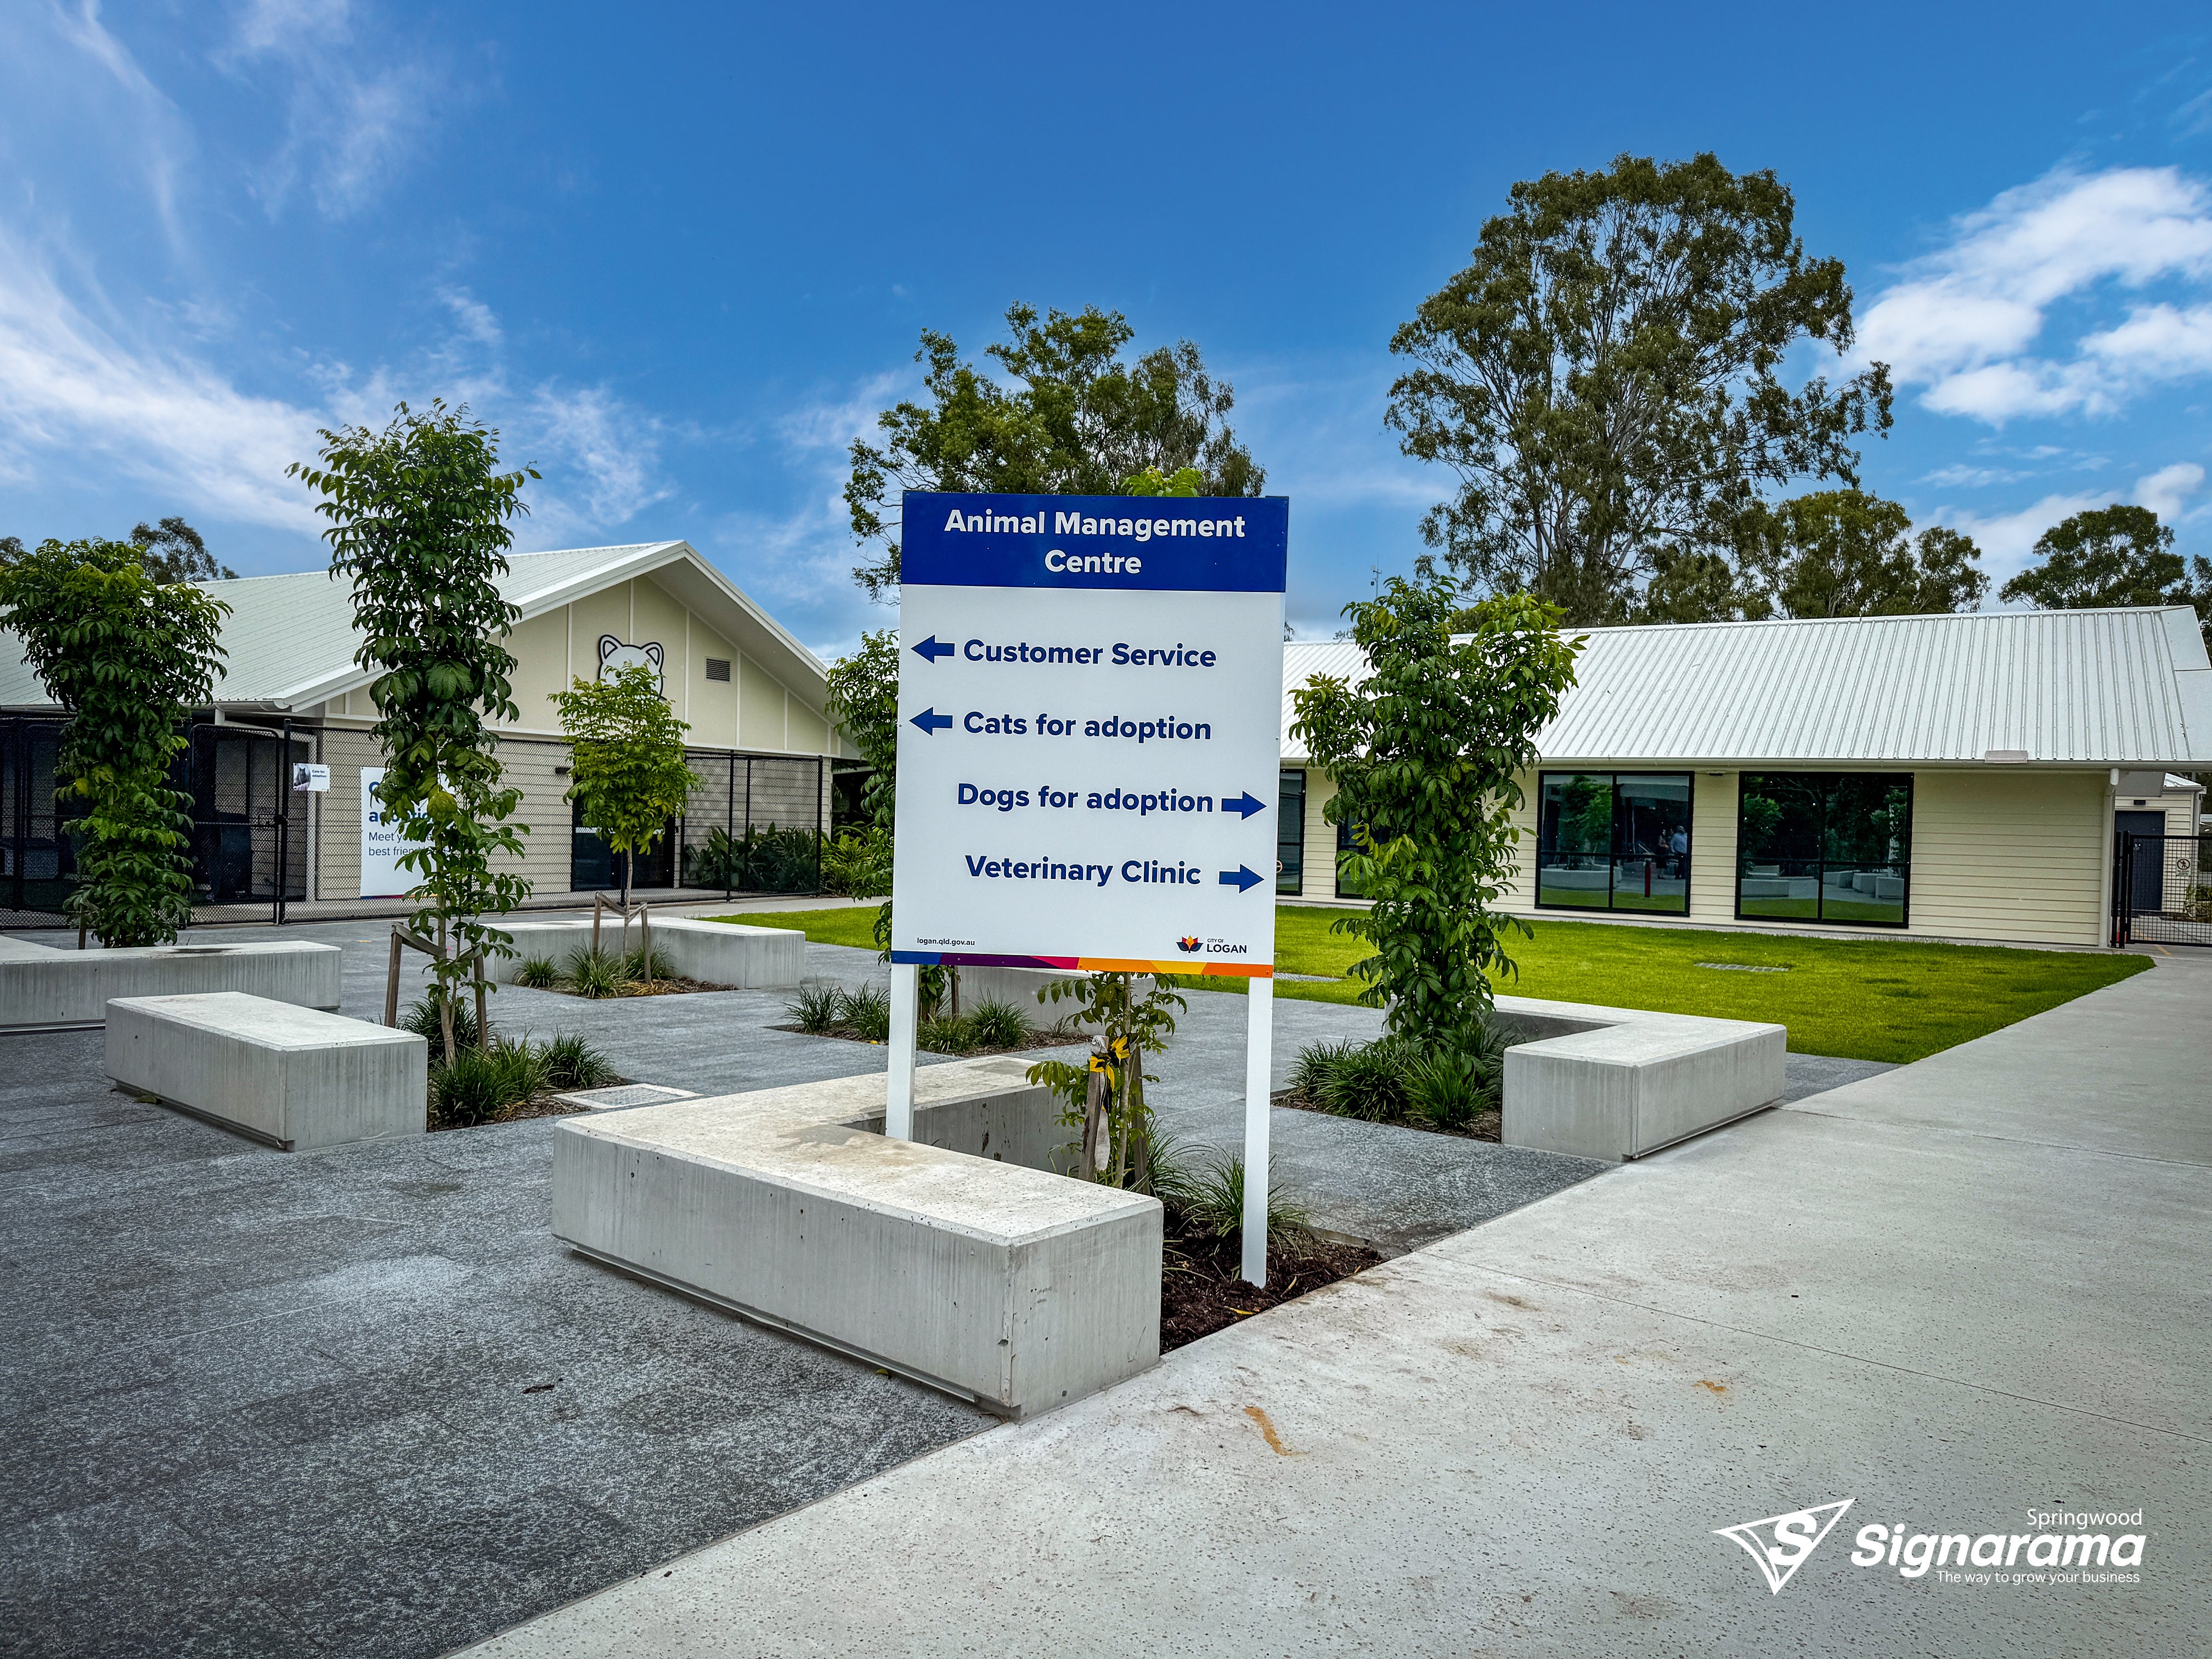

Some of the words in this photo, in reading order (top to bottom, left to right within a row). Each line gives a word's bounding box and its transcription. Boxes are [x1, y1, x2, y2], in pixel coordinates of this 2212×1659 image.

[944, 509, 1045, 534] Animal
[1055, 511, 1245, 542] Management
[1045, 549, 1142, 574] Centre
[963, 639, 1103, 664] Customer
[1111, 642, 1217, 667] Service
[963, 711, 1028, 735] Cats
[1035, 713, 1076, 736] for
[1084, 715, 1211, 744] adoption
[958, 783, 1030, 812] Dogs
[1037, 785, 1079, 808] for
[1086, 788, 1213, 816] adoption
[369, 832, 394, 841] Meet
[369, 847, 390, 856] best
[964, 855, 1114, 887] Veterinary
[1121, 860, 1201, 885] Clinic
[917, 937, 975, 946] logan.qld.gov.au
[1206, 944, 1247, 953] LOGAN
